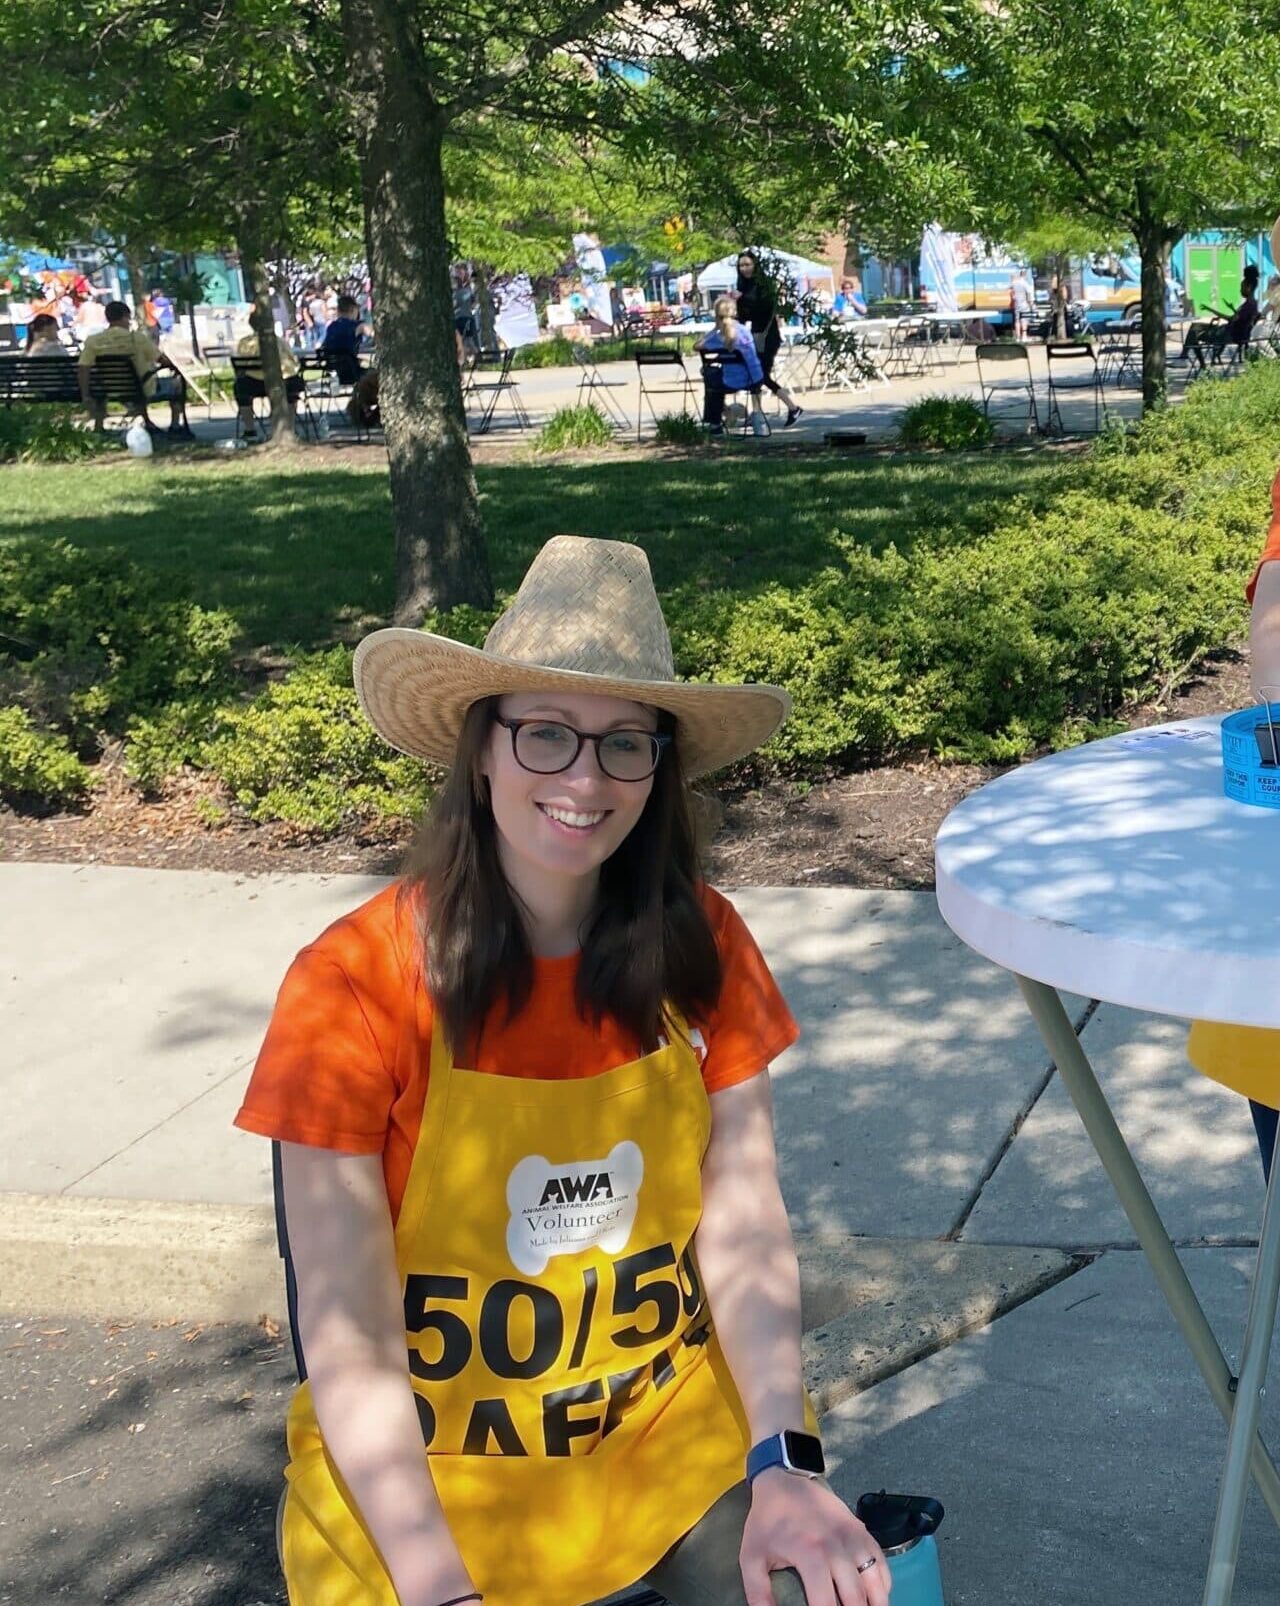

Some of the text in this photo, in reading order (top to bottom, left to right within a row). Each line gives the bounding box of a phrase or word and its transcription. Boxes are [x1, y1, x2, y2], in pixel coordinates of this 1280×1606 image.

[1258, 777, 1278, 786] KEEP
[539, 1172, 613, 1206] AWA
[521, 1195, 629, 1215] ANIMAL WELFARE ASSOCIATION
[525, 1207, 623, 1232] Volunteer
